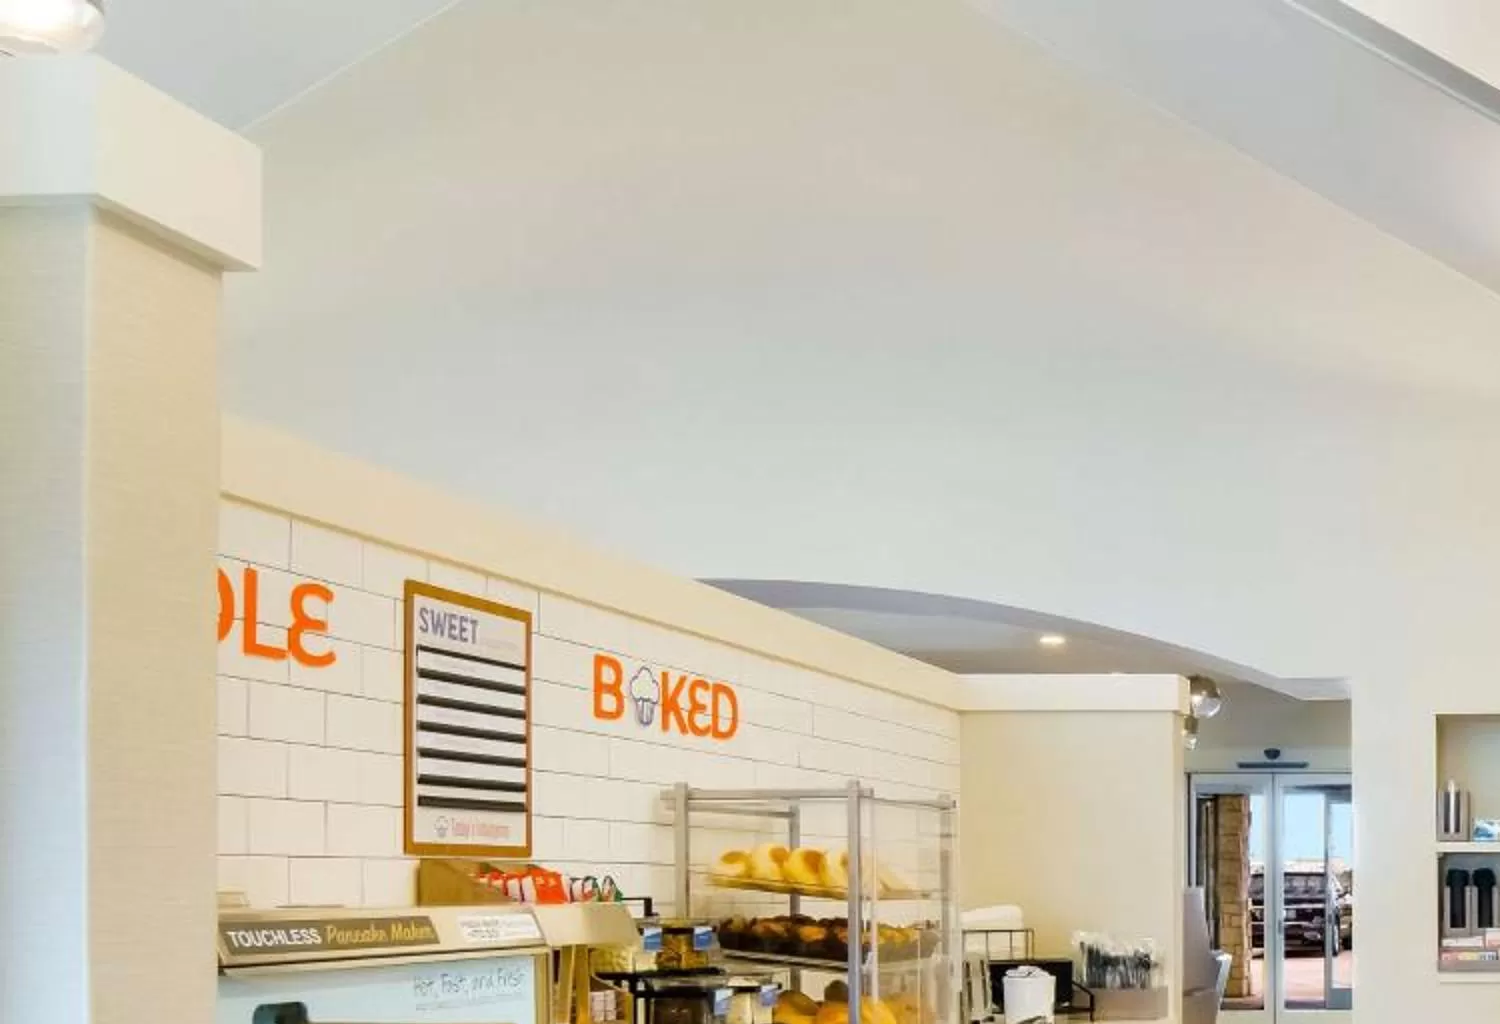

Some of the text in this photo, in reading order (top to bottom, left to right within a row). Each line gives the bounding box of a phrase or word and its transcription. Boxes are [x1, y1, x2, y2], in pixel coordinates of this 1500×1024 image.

[418, 607, 480, 645] SWEET
[592, 653, 740, 741] BKED
[226, 928, 322, 948] TOUCHLESS
[325, 923, 388, 945] Pancake
